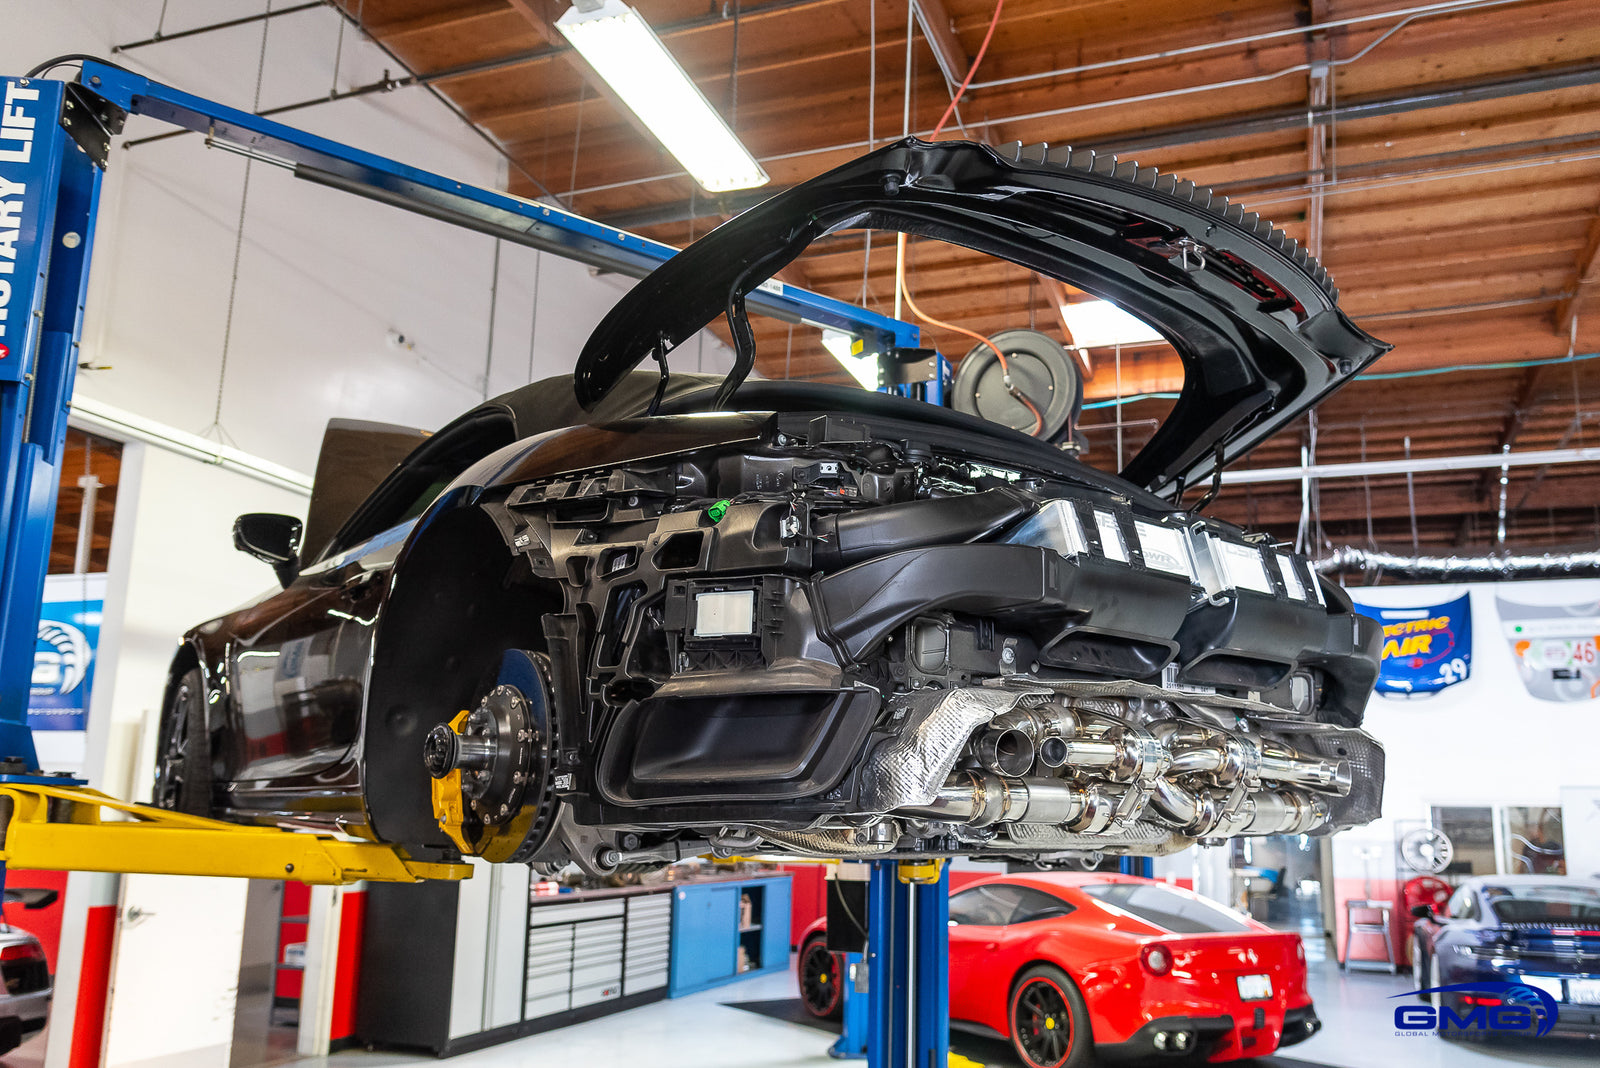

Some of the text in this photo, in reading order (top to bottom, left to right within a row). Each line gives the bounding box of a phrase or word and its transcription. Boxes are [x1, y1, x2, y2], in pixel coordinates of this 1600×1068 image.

[0, 81, 40, 337] ARY LIFT
[1382, 616, 1450, 638] ECTRIC
[1381, 634, 1432, 660] AIR
[1573, 642, 1594, 663] 46
[1439, 658, 1467, 685] 29
